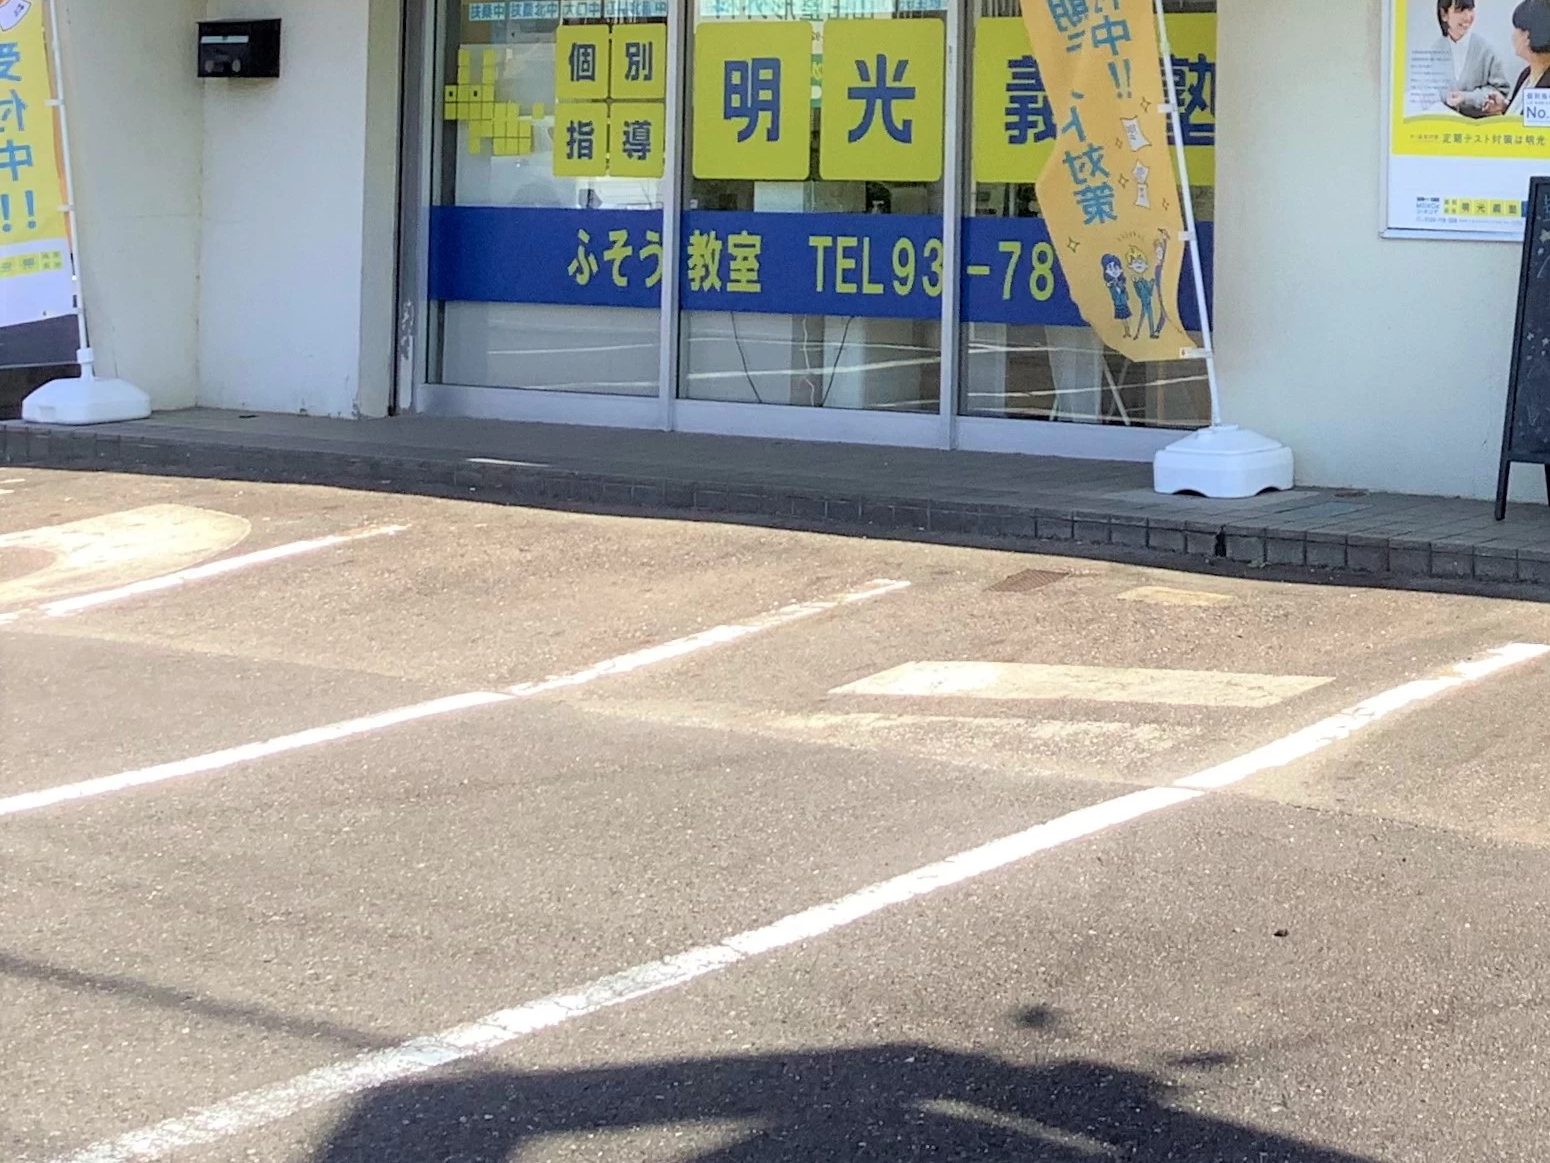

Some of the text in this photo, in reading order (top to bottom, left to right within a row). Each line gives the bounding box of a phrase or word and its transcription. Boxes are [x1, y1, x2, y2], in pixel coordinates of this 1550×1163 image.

[567, 228, 763, 294] ふそう教室
